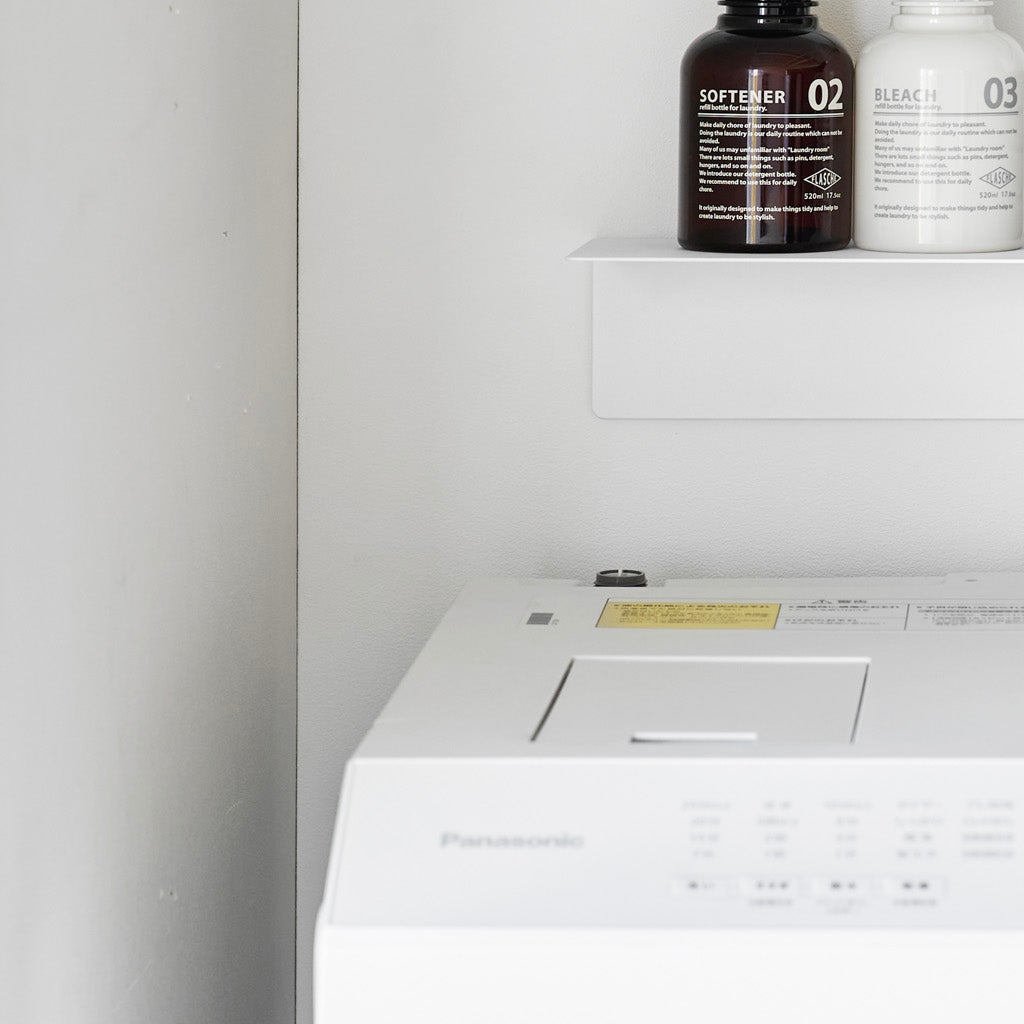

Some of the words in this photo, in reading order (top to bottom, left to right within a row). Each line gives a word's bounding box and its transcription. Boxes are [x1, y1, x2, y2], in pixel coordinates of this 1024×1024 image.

[700, 89, 786, 104] SOFTENER
[808, 78, 843, 111] 02
[875, 88, 936, 102] BLEACH
[984, 76, 1018, 109] 03
[440, 832, 585, 849] Panasonic
